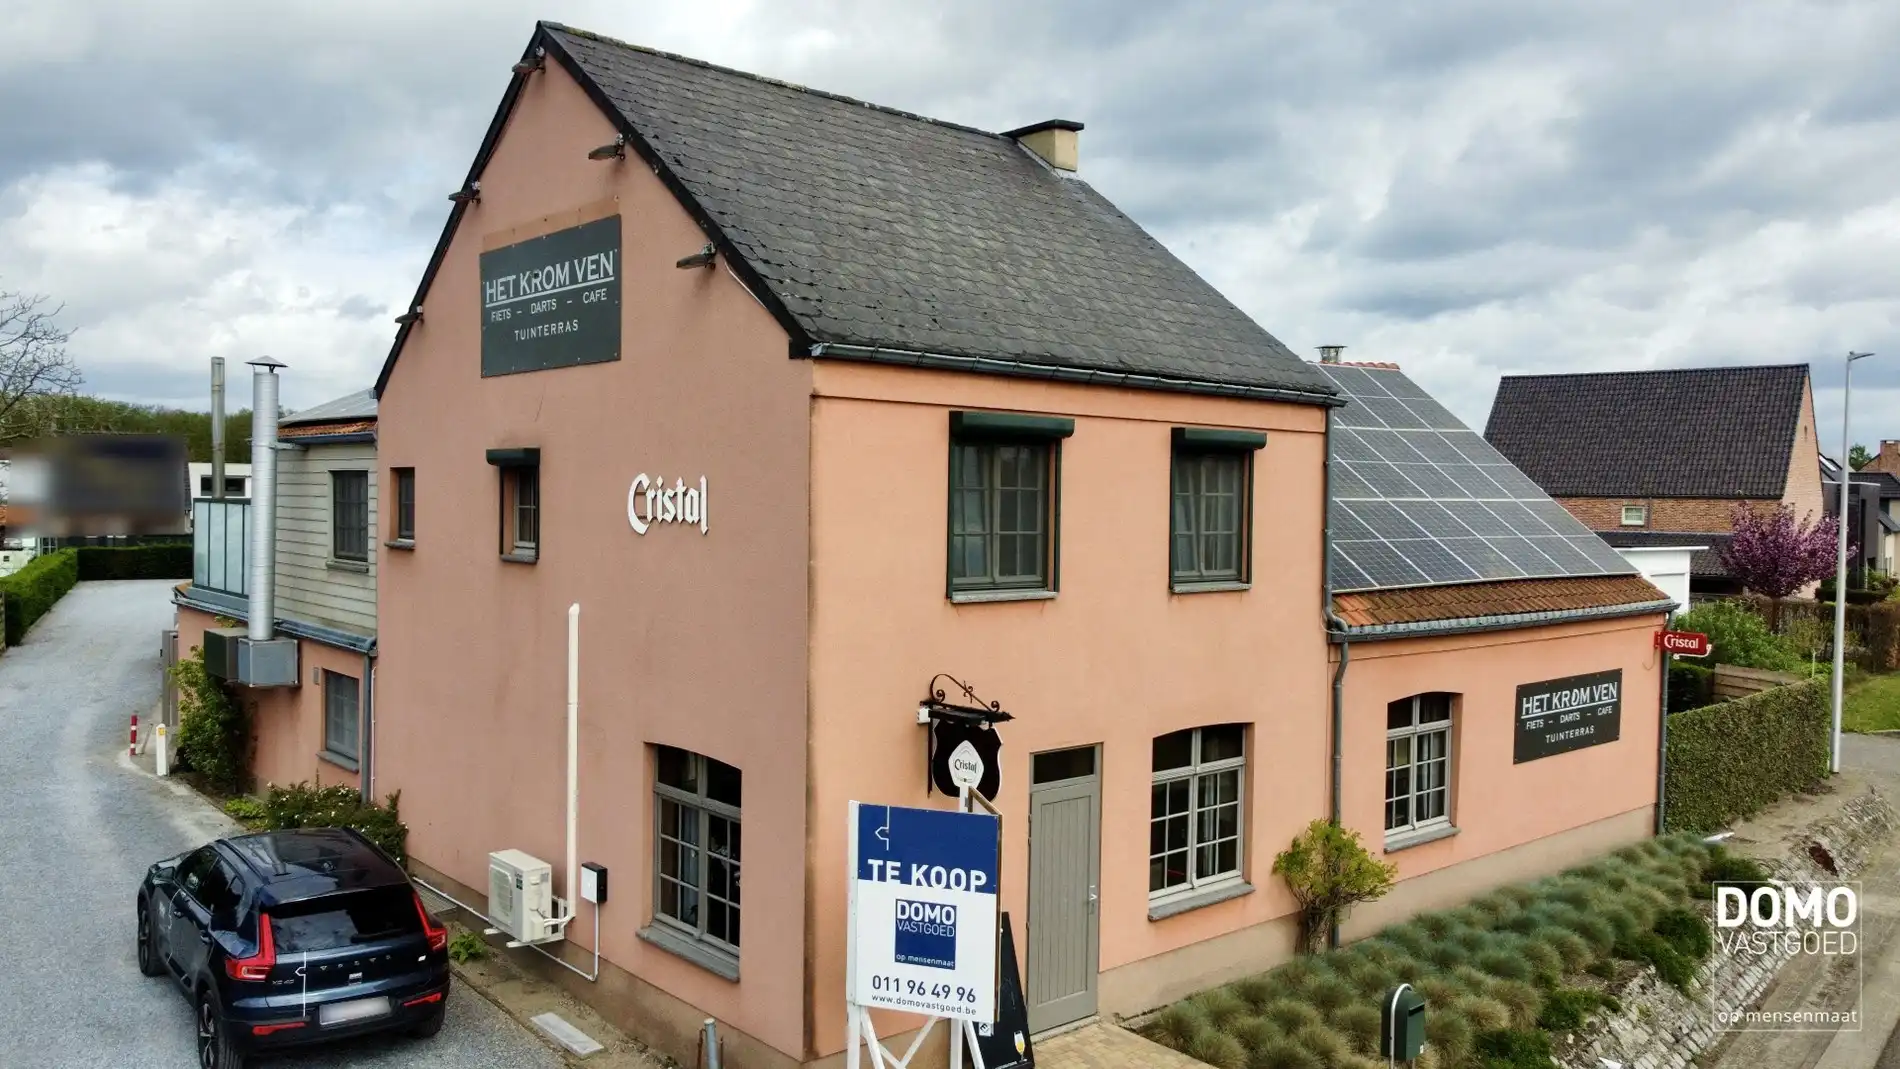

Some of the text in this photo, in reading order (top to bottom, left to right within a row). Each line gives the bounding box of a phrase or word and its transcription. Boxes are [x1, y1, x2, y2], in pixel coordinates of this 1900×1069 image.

[486, 250, 614, 303] HET KROM VEN
[491, 308, 512, 322] FIETS
[530, 299, 557, 314] DARTS
[583, 288, 607, 304] CAFE
[515, 319, 579, 341] TUINTERRAS
[627, 472, 709, 535] Cristal
[1664, 633, 1699, 650] Cristal
[1521, 681, 1618, 716] HET KROM VEN
[1526, 720, 1544, 730] FIETS
[1560, 712, 1580, 724] DARTS
[1597, 705, 1613, 716] CAFE
[1545, 725, 1595, 744] TUINTERRAS
[954, 759, 977, 774] Cristal
[867, 858, 987, 893] TE KOOP
[896, 900, 955, 925] DOMO
[896, 920, 955, 938] VASTGOED
[896, 953, 955, 968] op mensenmaat
[872, 975, 976, 1003] 011 96 49 96
[872, 995, 977, 1016] www.domovastgoed.be
